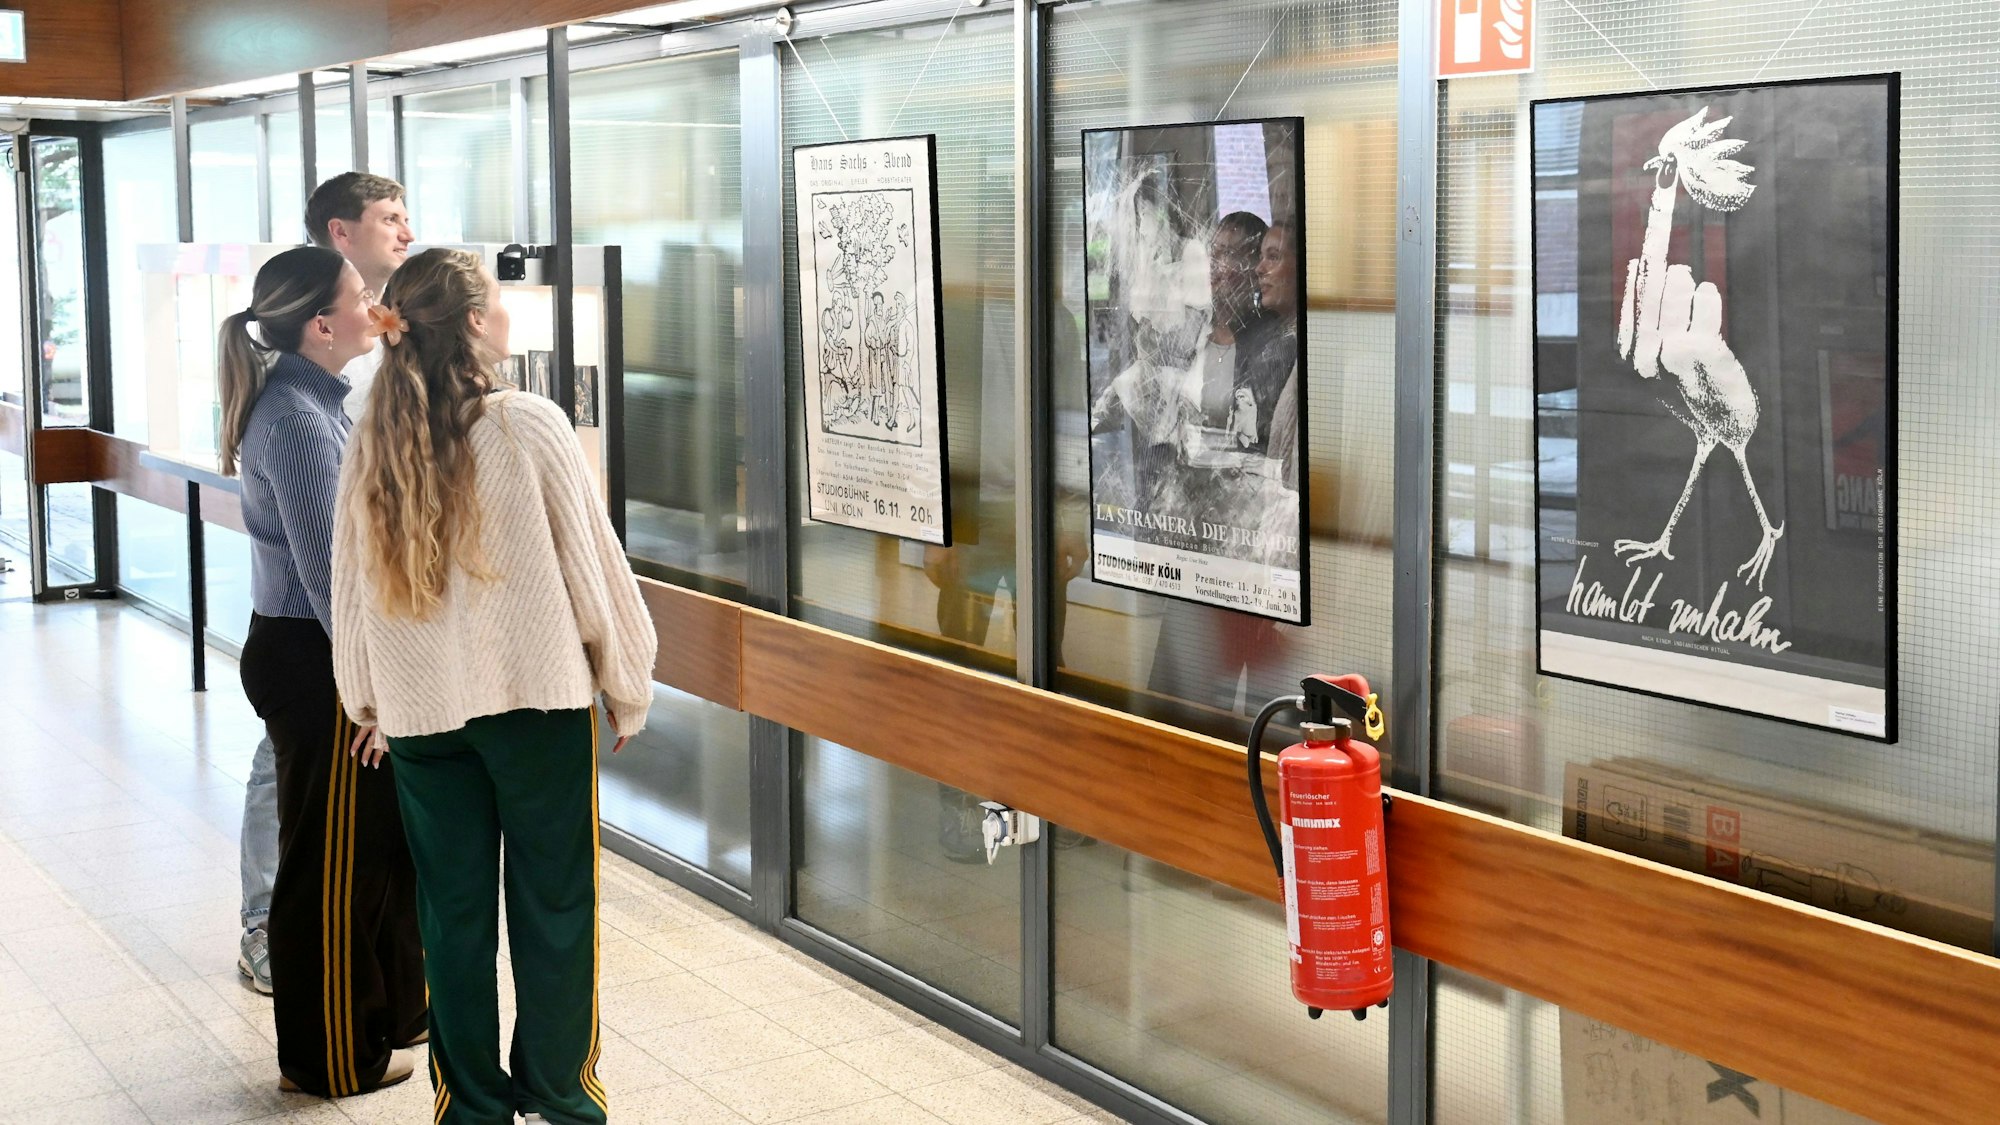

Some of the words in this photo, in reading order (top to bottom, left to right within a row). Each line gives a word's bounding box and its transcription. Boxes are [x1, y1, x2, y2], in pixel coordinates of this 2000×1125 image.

[884, 152, 912, 168] Abend
[816, 482, 870, 502] STUDIOBÜHNE
[824, 500, 838, 514] UNI
[842, 502, 863, 518] KÖLN
[874, 498, 901, 518] 16.11.
[1096, 504, 1114, 522] LA
[1118, 508, 1197, 538] STRANIERA
[1202, 522, 1228, 542] DIE
[1097, 553, 1154, 577] STUDIOBÜHNE
[1158, 562, 1181, 581] KÖLN
[1196, 572, 1234, 588] Premiere:
[1292, 591, 1297, 602] h
[1566, 554, 1664, 624] hamlet
[1195, 586, 1240, 602] Vorstellungen:
[1284, 604, 1292, 613] 20
[1292, 605, 1298, 615] h
[1711, 646, 1731, 656] RITUAL
